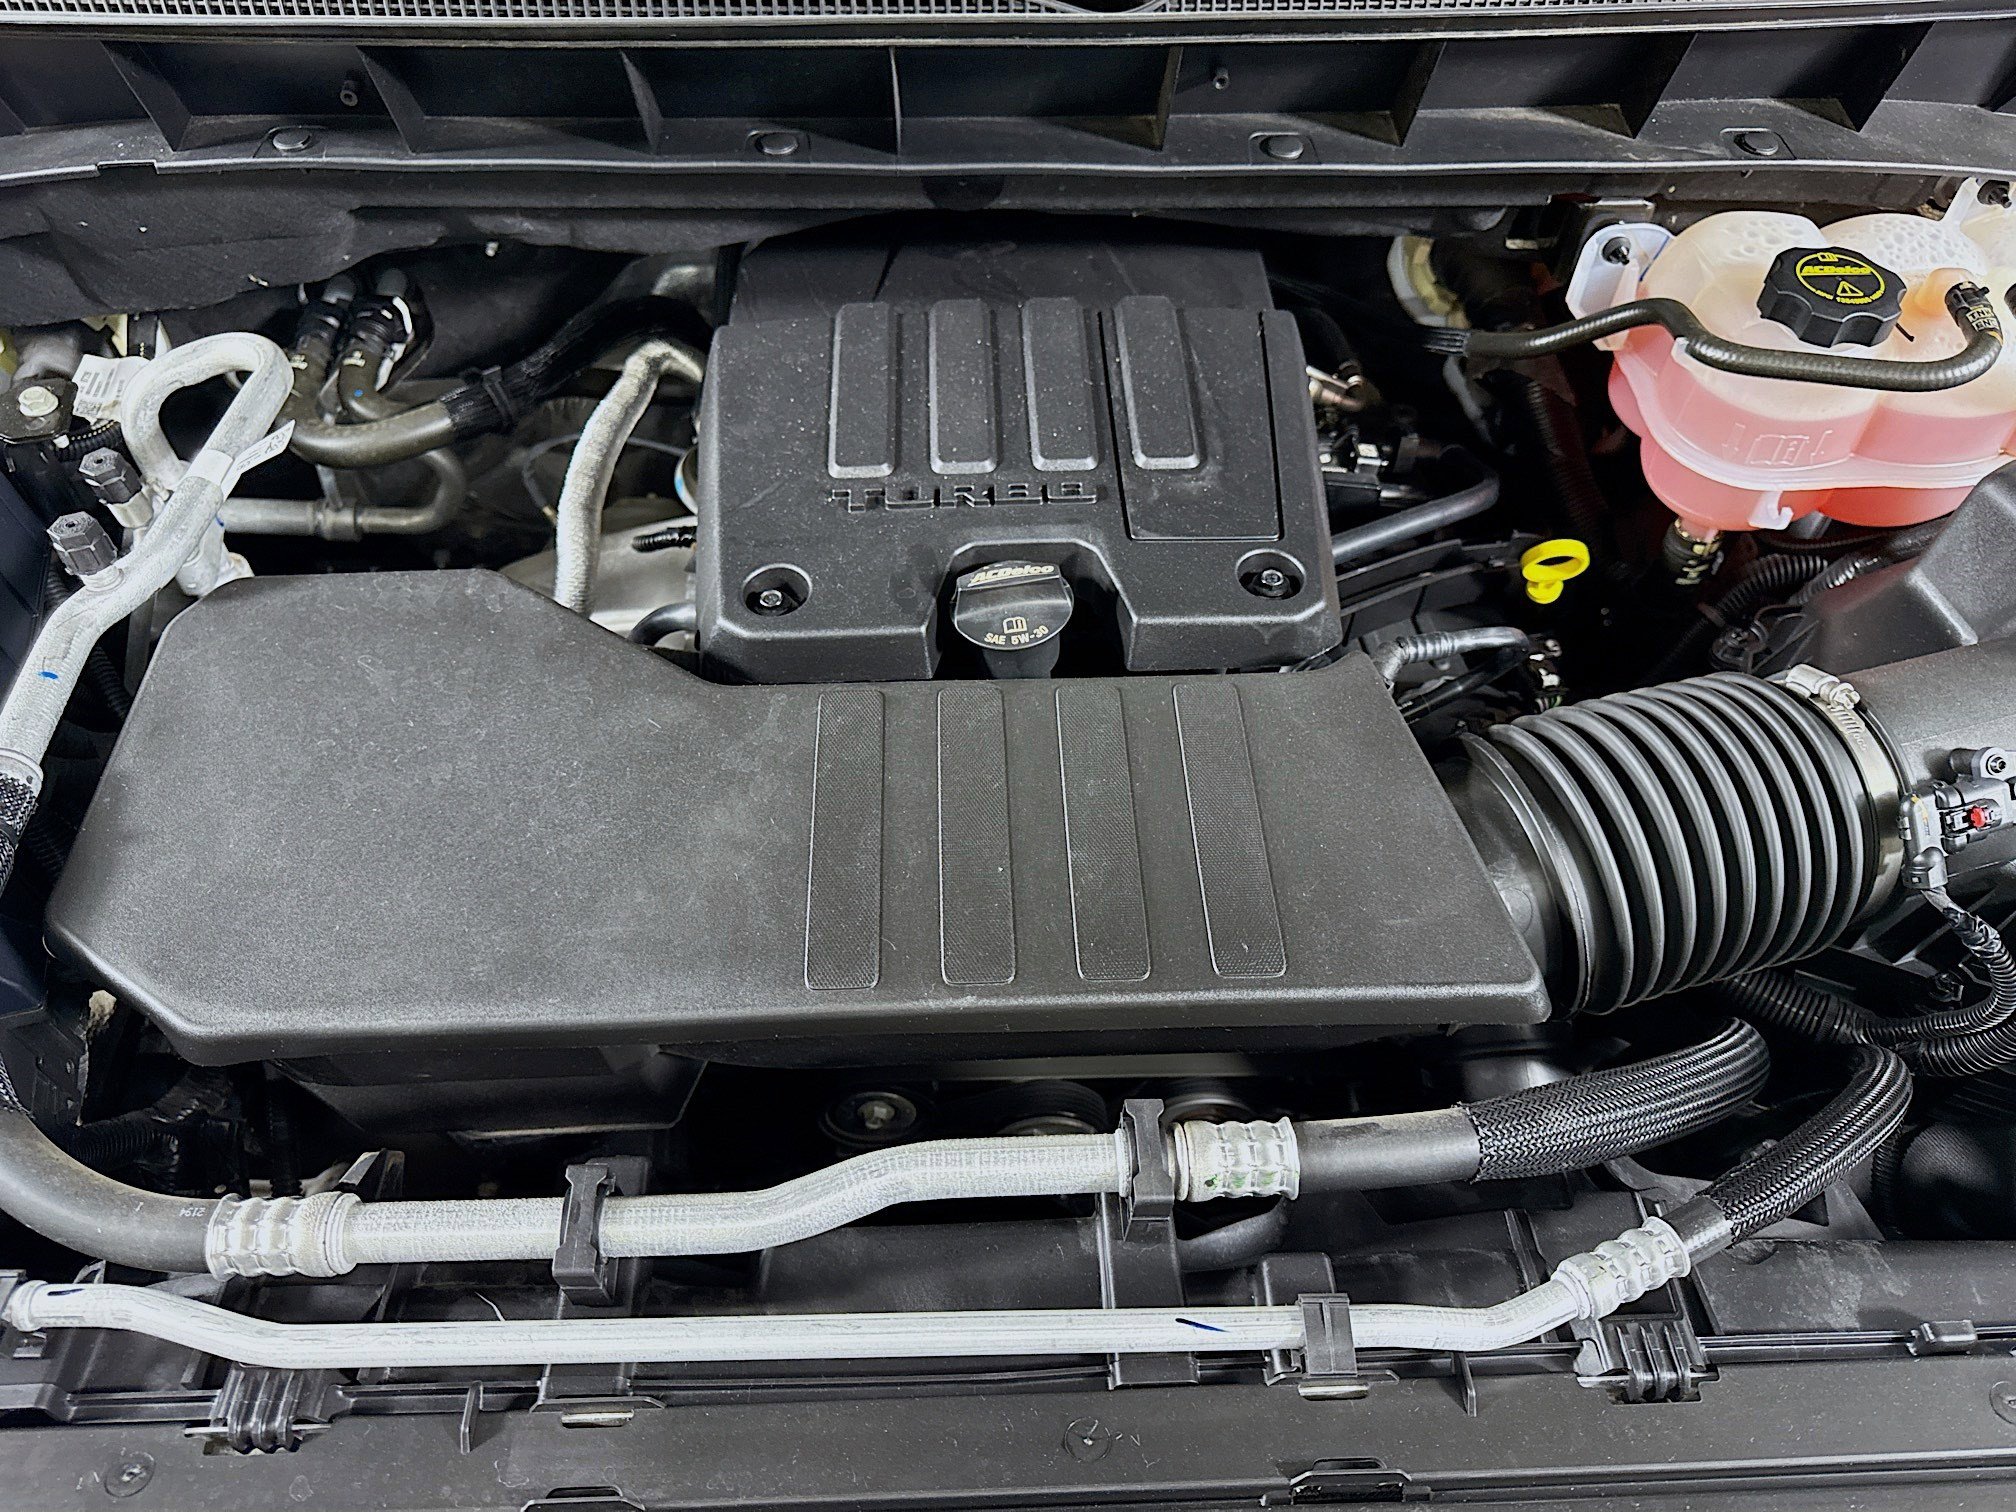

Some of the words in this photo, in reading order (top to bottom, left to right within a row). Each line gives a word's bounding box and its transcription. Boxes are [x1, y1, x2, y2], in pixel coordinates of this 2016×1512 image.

[829, 479, 1097, 513] TURBO
[970, 565, 1055, 584] ACDelco
[984, 632, 1006, 645] SAE
[1010, 624, 1049, 645] 5W-30
